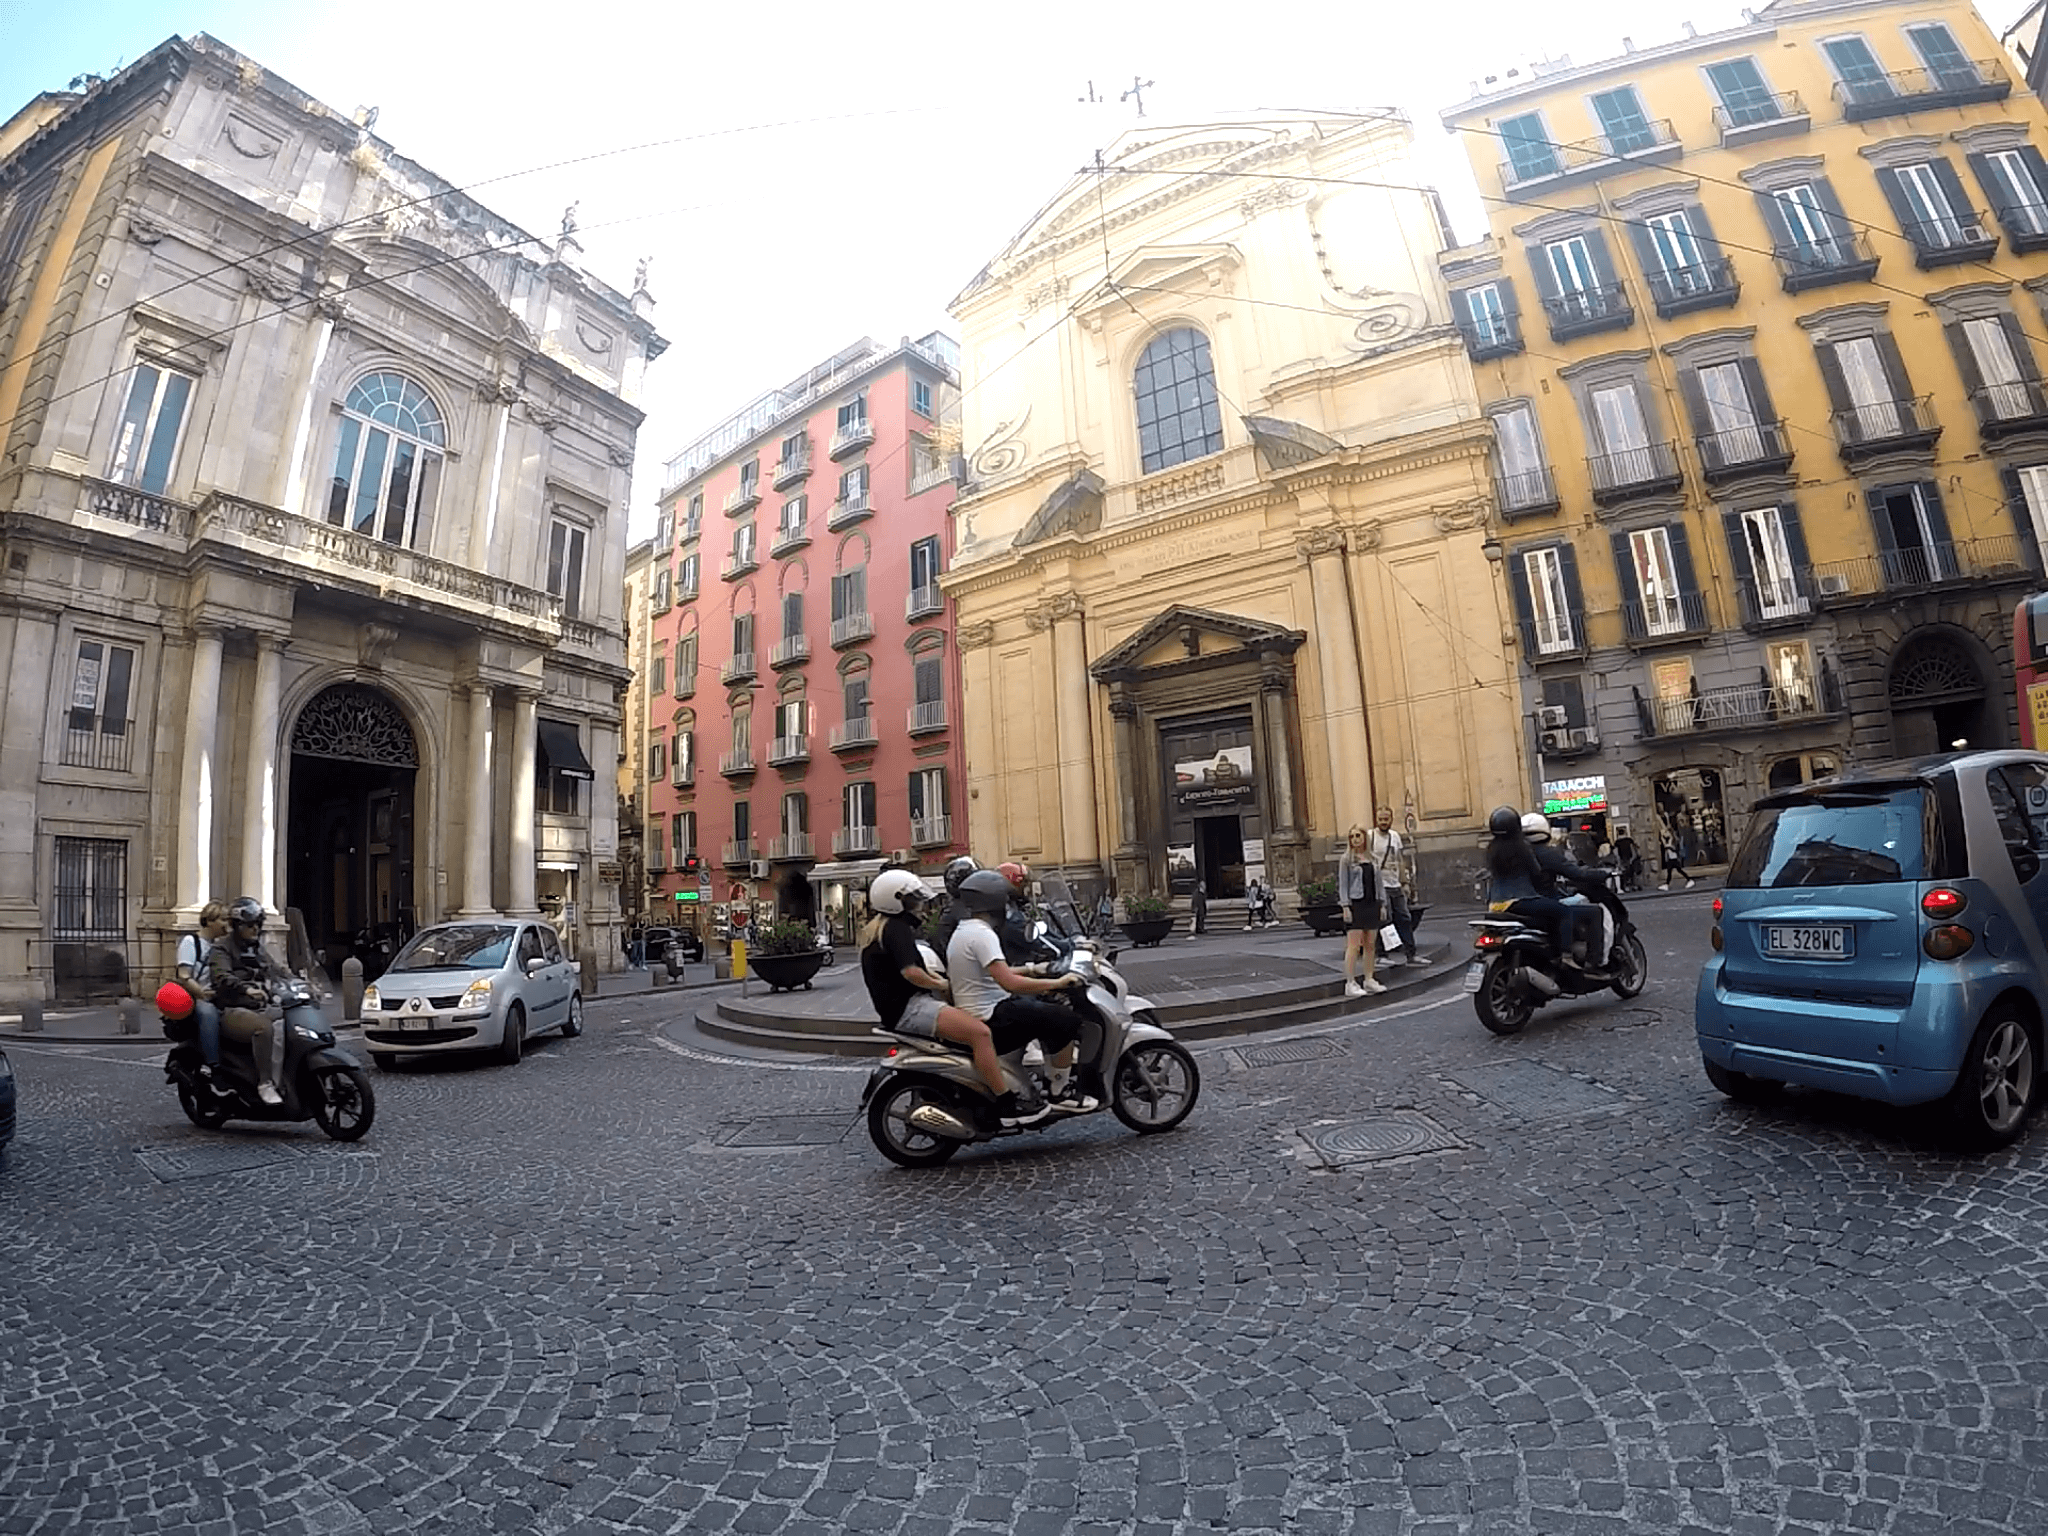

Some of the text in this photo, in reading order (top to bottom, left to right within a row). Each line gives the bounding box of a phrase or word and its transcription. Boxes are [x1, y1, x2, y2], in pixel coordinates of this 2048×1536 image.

[1542, 775, 1605, 794] TABACCHI
[1660, 776, 1712, 793] VANAS
[1770, 929, 1842, 951] EL 328WC
